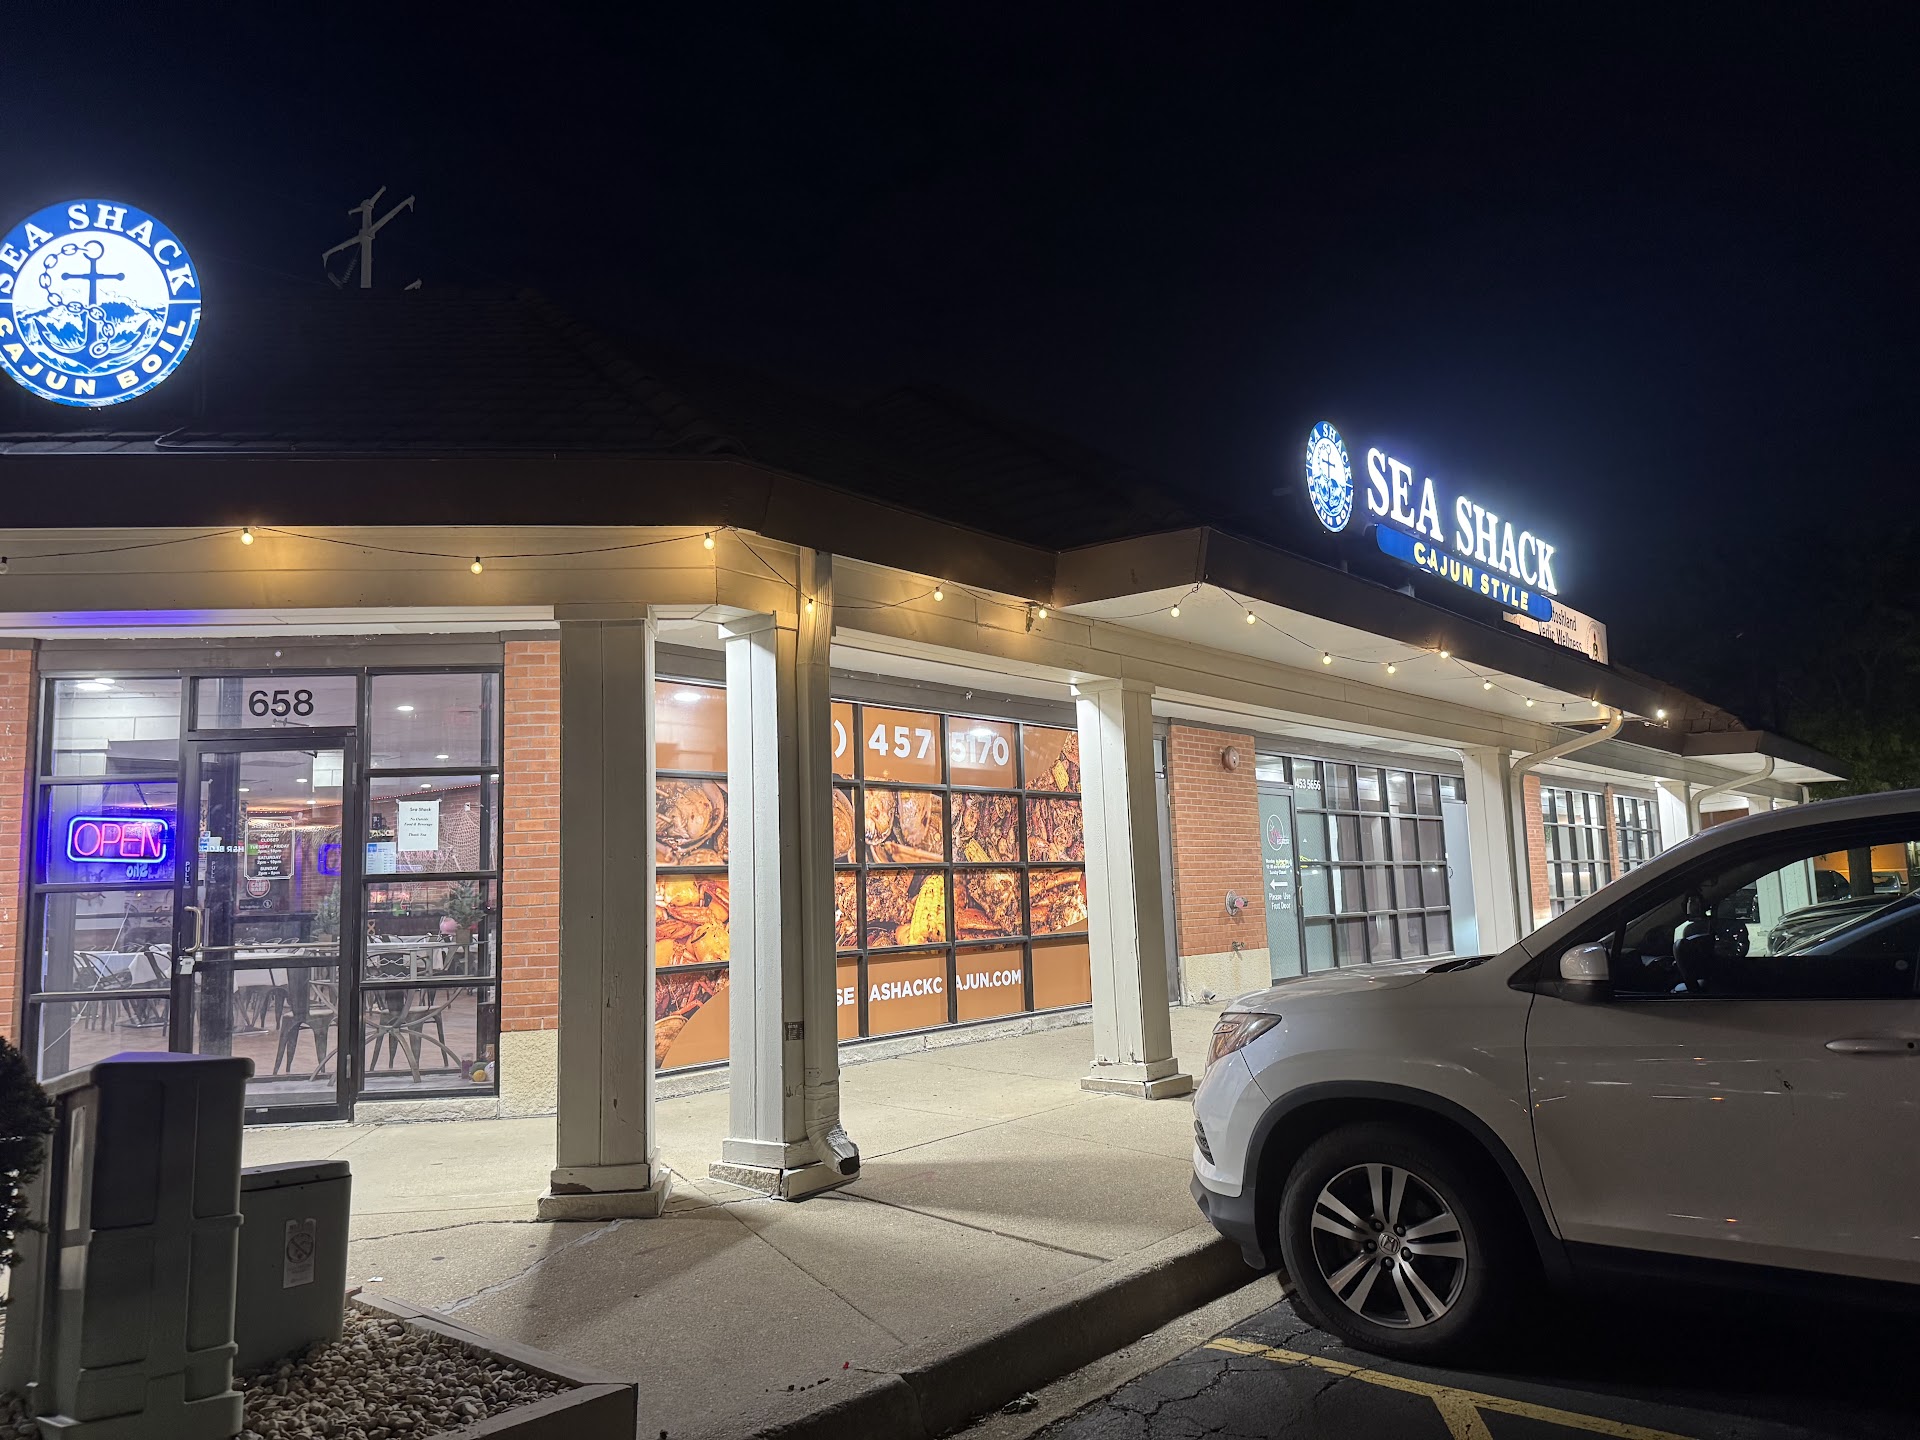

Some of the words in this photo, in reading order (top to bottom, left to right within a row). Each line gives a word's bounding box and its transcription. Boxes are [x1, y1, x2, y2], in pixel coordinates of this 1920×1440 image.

[0, 223, 54, 294] SEA
[67, 204, 196, 295] SHACK
[0, 317, 96, 395] CAJUN
[116, 320, 186, 389] BOIL
[1306, 428, 1320, 464] SEA
[1322, 424, 1352, 479] SHACK
[1336, 495, 1350, 526] BOIL
[1366, 447, 1444, 543] SEA
[1455, 495, 1558, 596] SHACK
[1414, 541, 1473, 588] CAJUN
[1480, 573, 1529, 611] STYLE
[248, 689, 314, 717] 658
[868, 724, 932, 759] 457
[951, 731, 1009, 766] 5170
[74, 822, 163, 857] OPEN
[1268, 892, 1282, 900] Please
[1282, 892, 1291, 900] Use
[1280, 901, 1291, 910] Door
